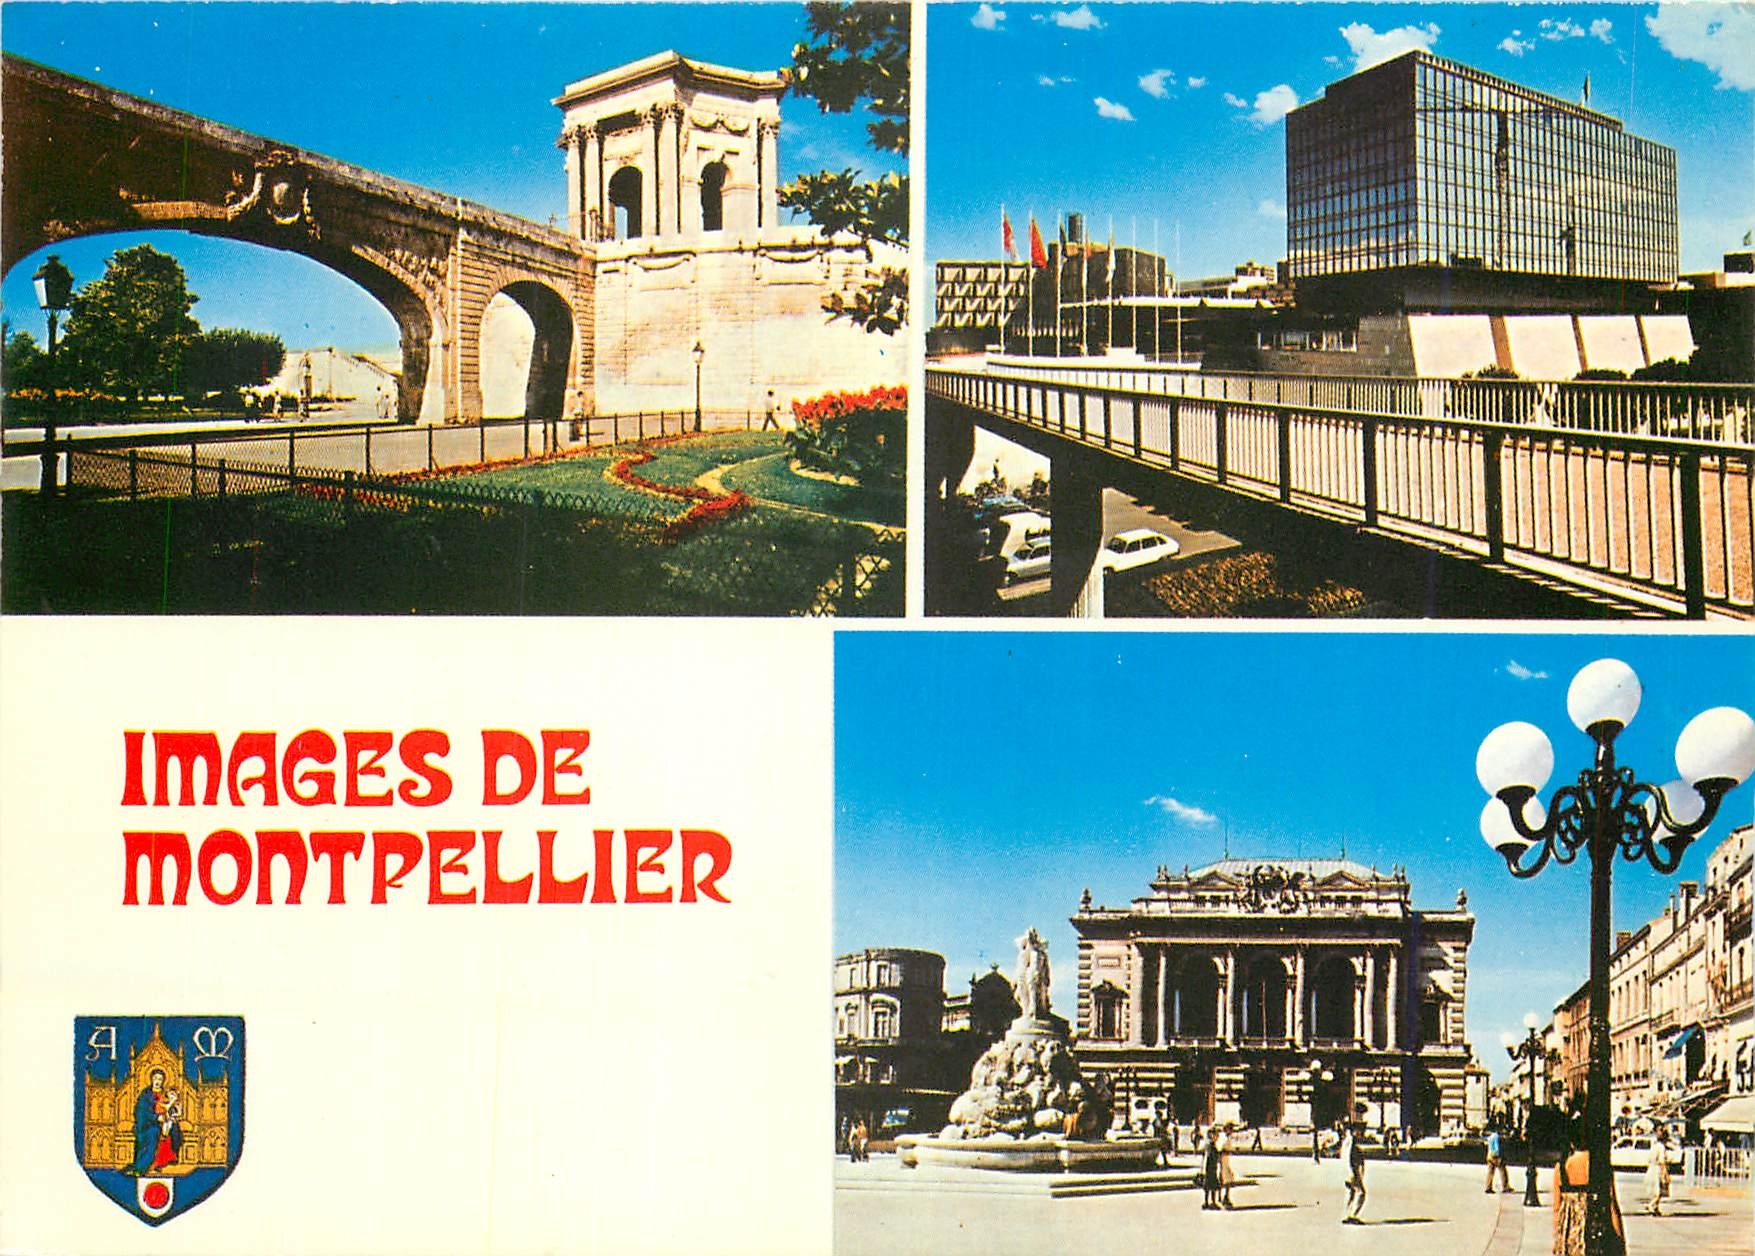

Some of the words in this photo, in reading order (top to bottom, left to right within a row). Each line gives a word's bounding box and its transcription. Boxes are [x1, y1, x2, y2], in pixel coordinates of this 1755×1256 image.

[121, 730, 452, 806] IMAGES
[482, 730, 590, 806] DE
[123, 830, 732, 905] MONTPELLIER
[85, 1026, 117, 1062] A
[193, 1026, 235, 1062] M
